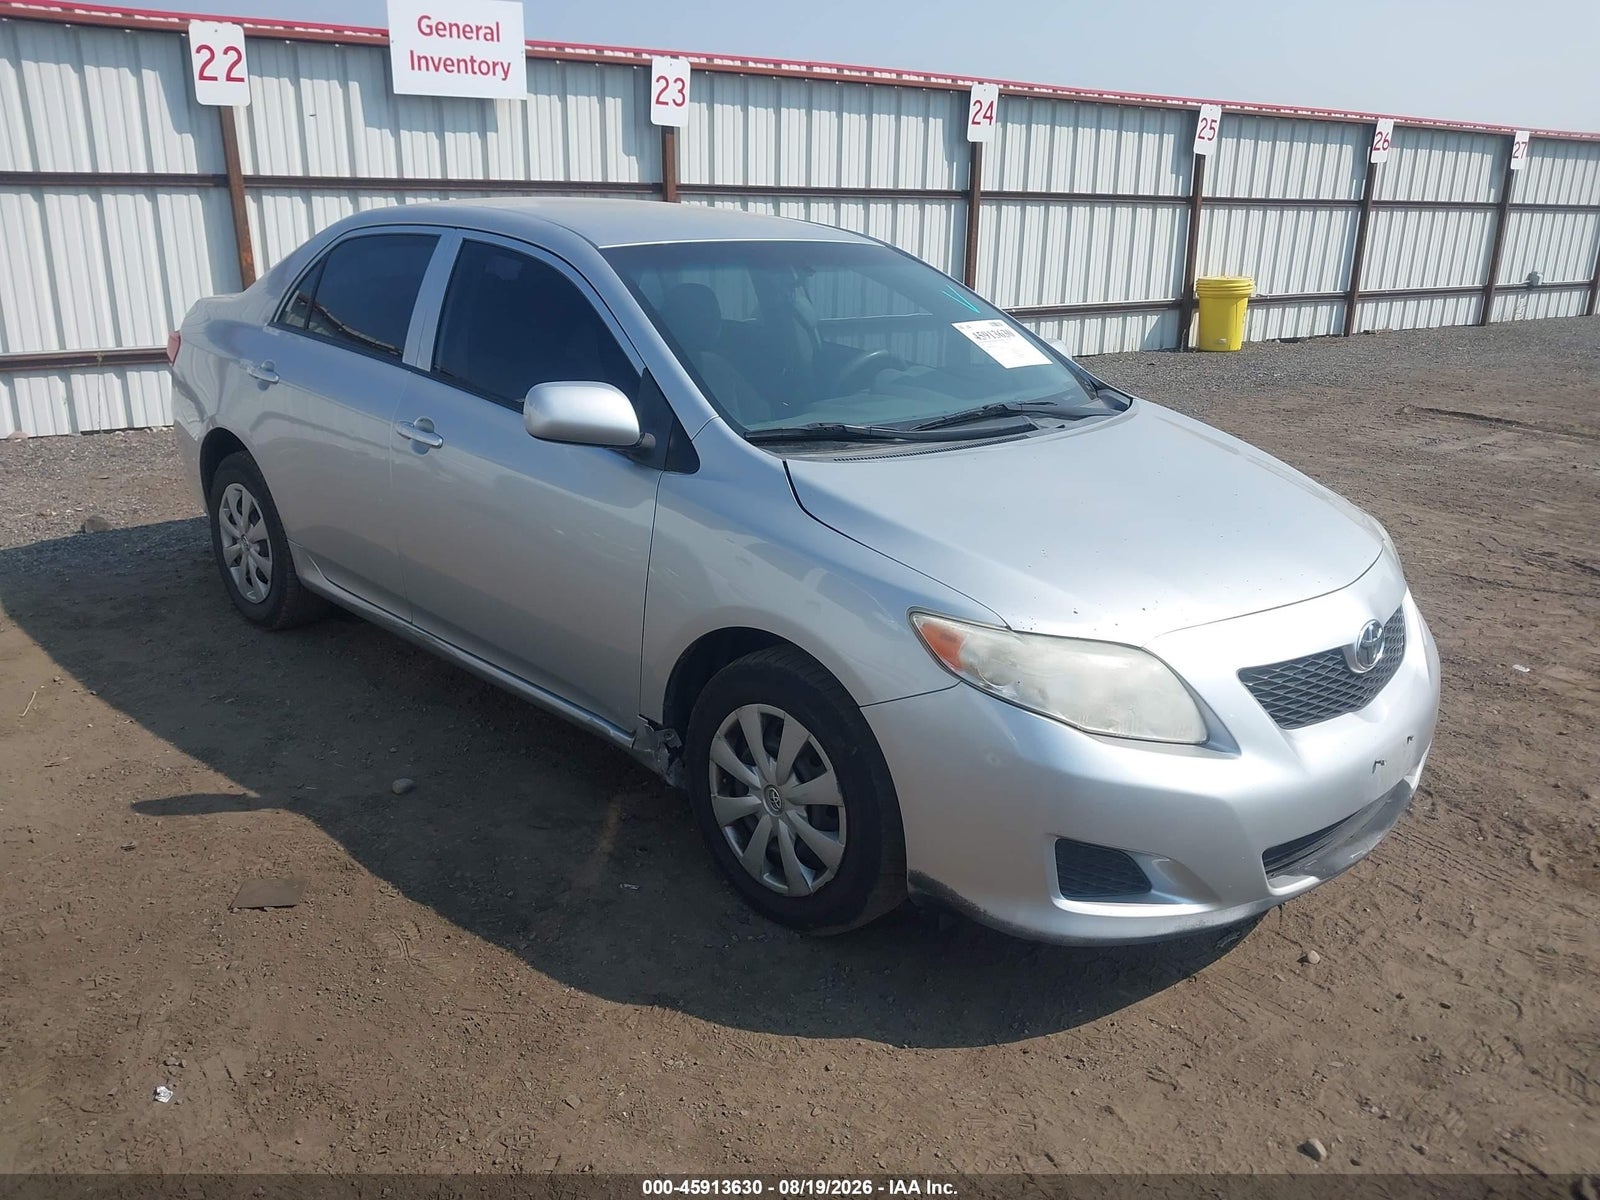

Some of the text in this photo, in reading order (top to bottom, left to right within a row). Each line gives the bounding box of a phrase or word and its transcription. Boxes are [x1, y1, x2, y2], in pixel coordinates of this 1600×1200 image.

[417, 15, 501, 43] General
[195, 44, 245, 83] 22
[409, 52, 512, 81] Inventory
[655, 75, 687, 108] 23
[971, 99, 994, 126] 24
[1197, 117, 1217, 141] 25
[1373, 131, 1390, 151] 26
[1512, 141, 1528, 159] 27
